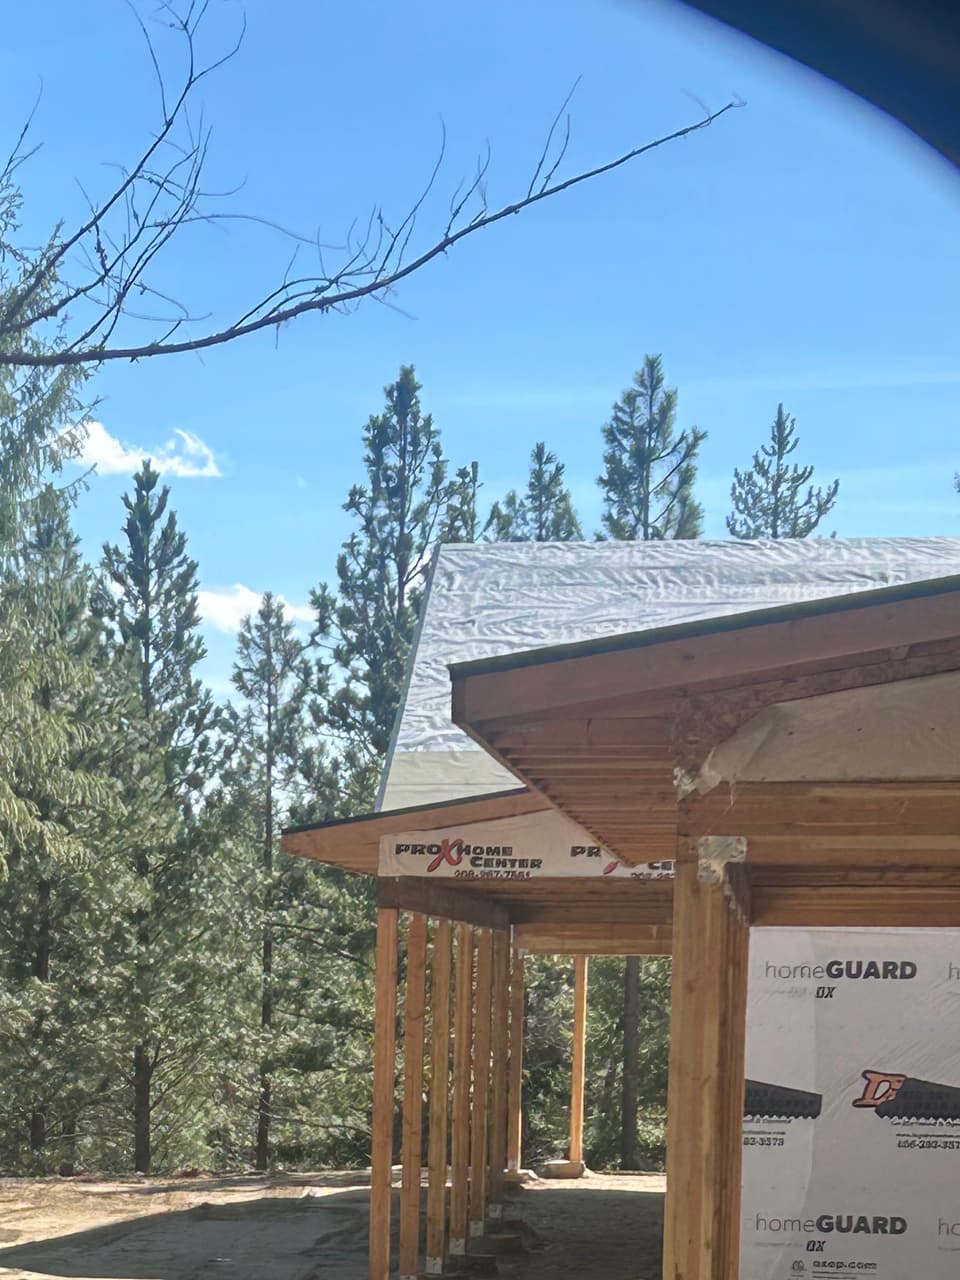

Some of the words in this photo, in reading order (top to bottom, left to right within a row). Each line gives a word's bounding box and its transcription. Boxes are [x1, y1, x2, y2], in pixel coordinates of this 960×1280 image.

[470, 856, 543, 869] CENTER
[765, 961, 917, 980] homeGUARD
[755, 1213, 907, 1234] homeGUARD
